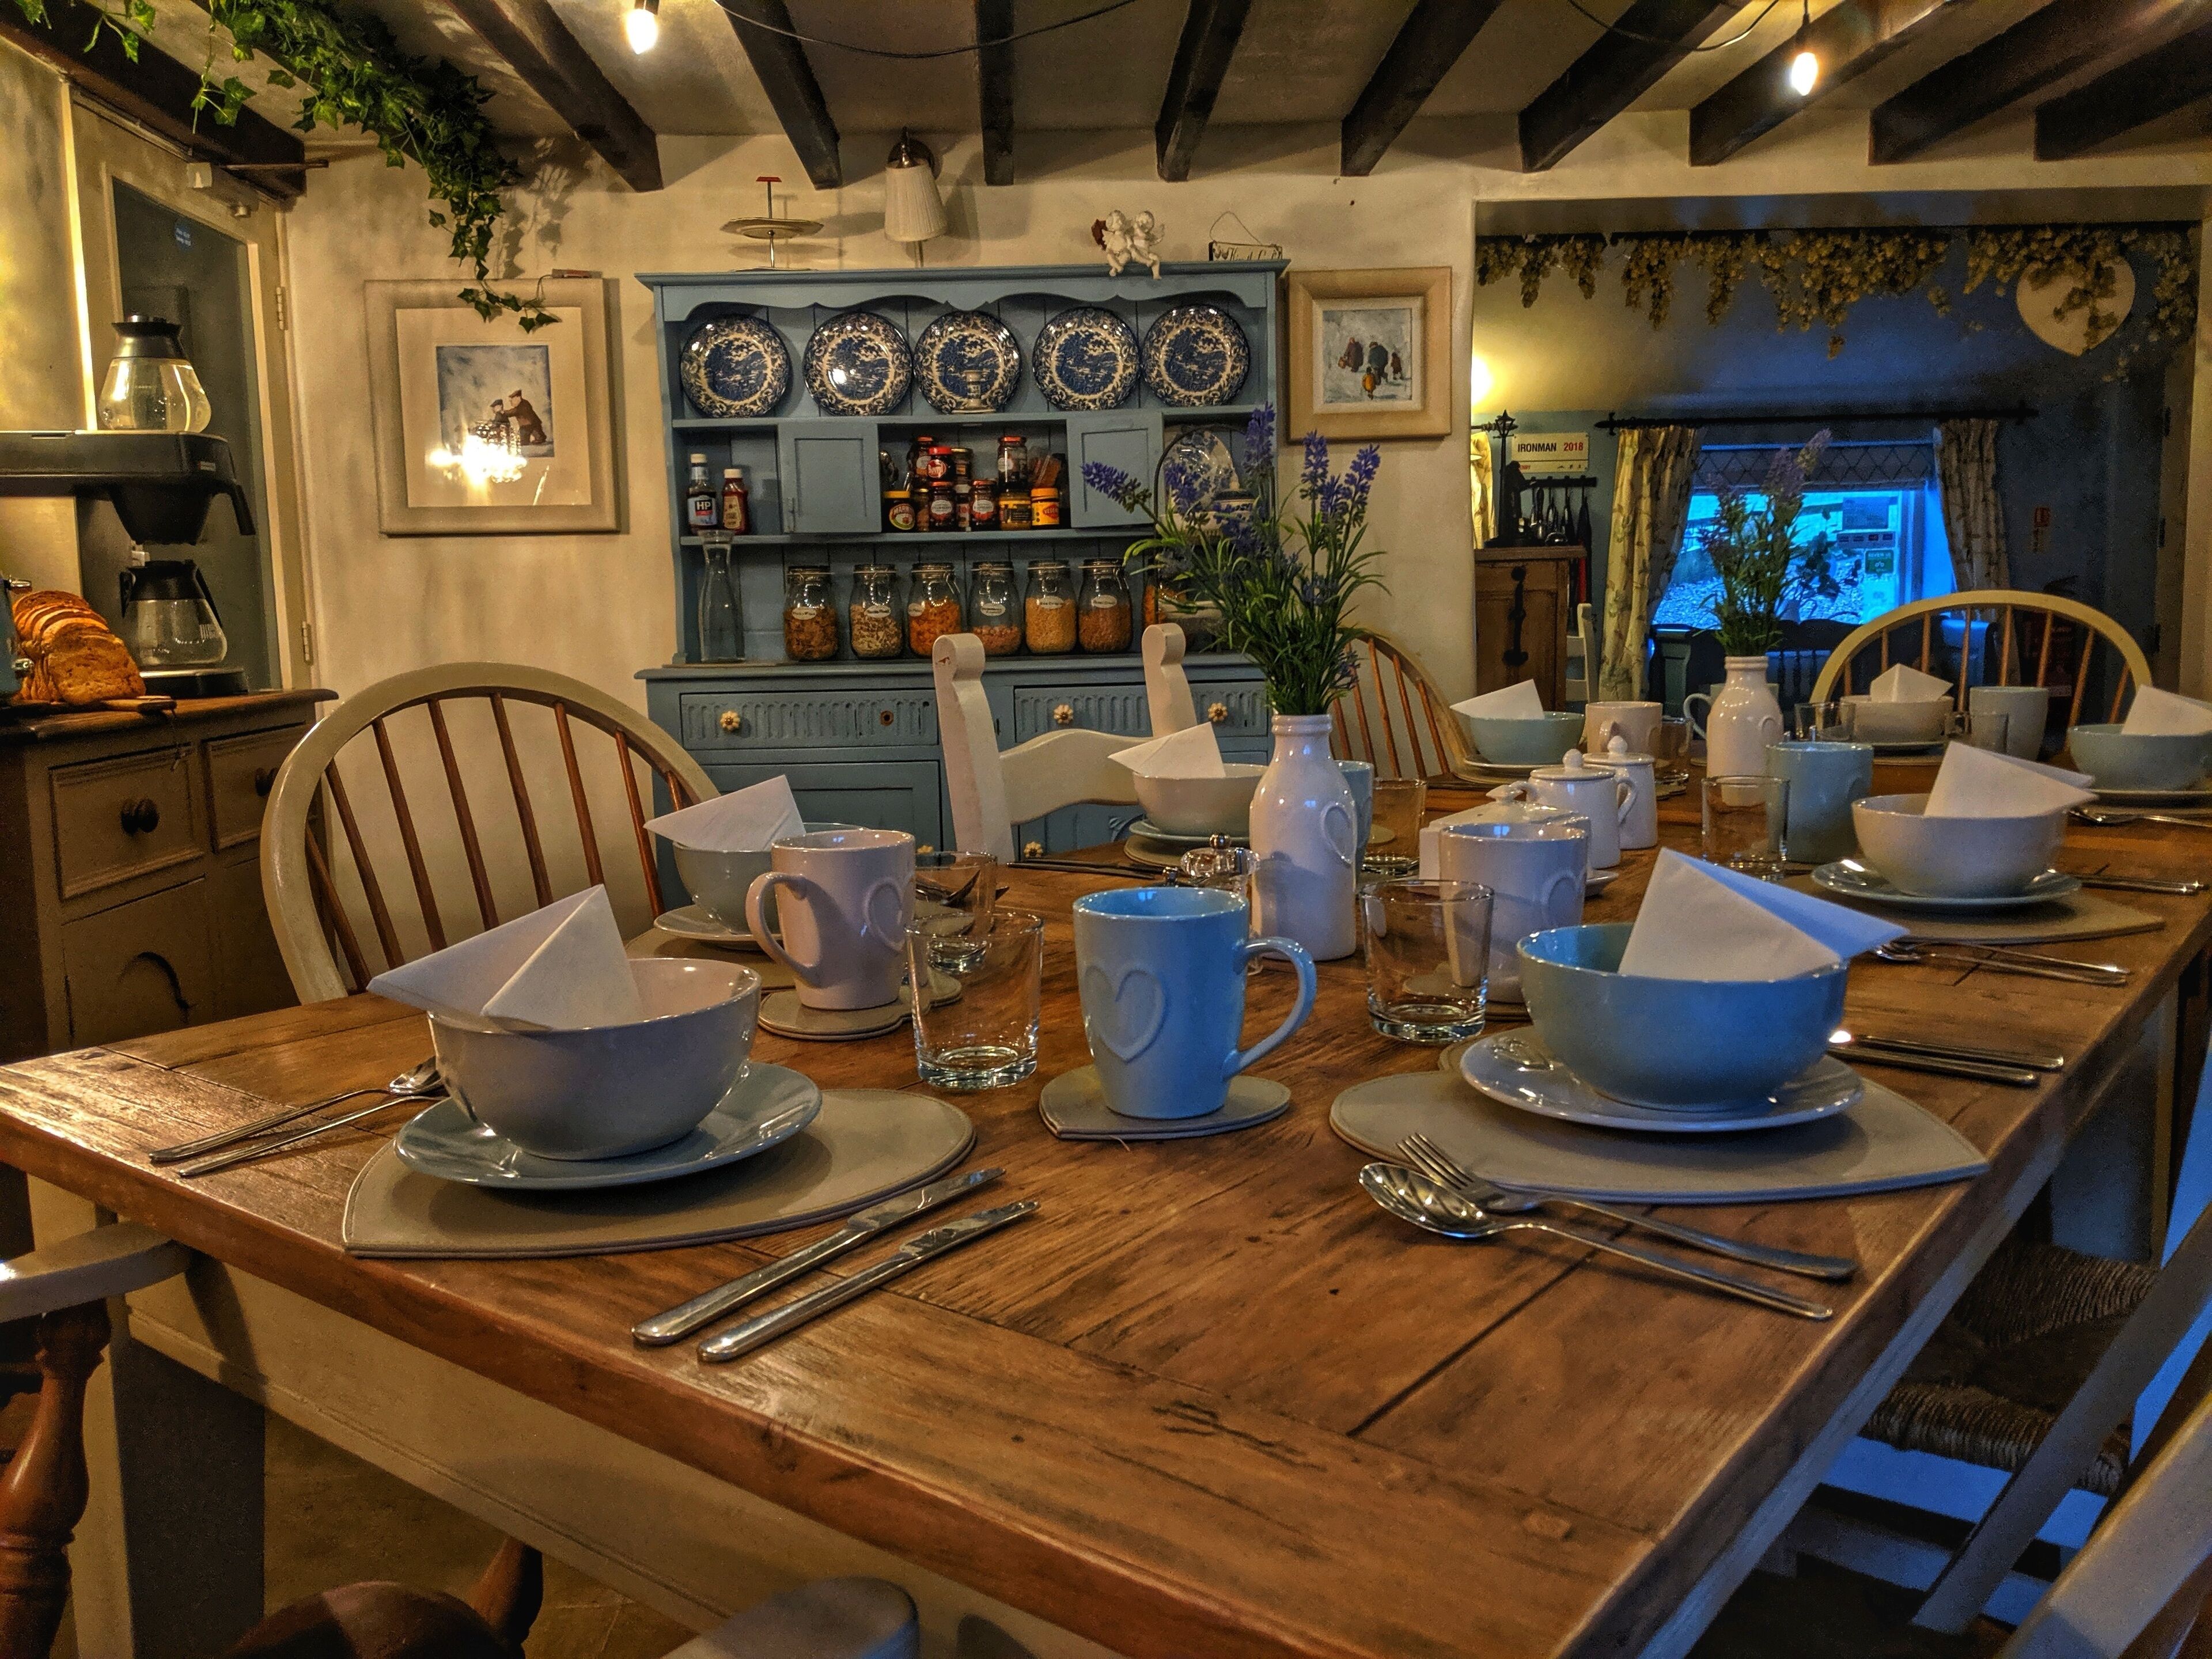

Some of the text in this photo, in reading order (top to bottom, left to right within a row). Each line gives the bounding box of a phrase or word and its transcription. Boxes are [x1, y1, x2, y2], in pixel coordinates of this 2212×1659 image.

[1518, 442, 1584, 452] IRONMAN 2018
[696, 502, 711, 510] HP
